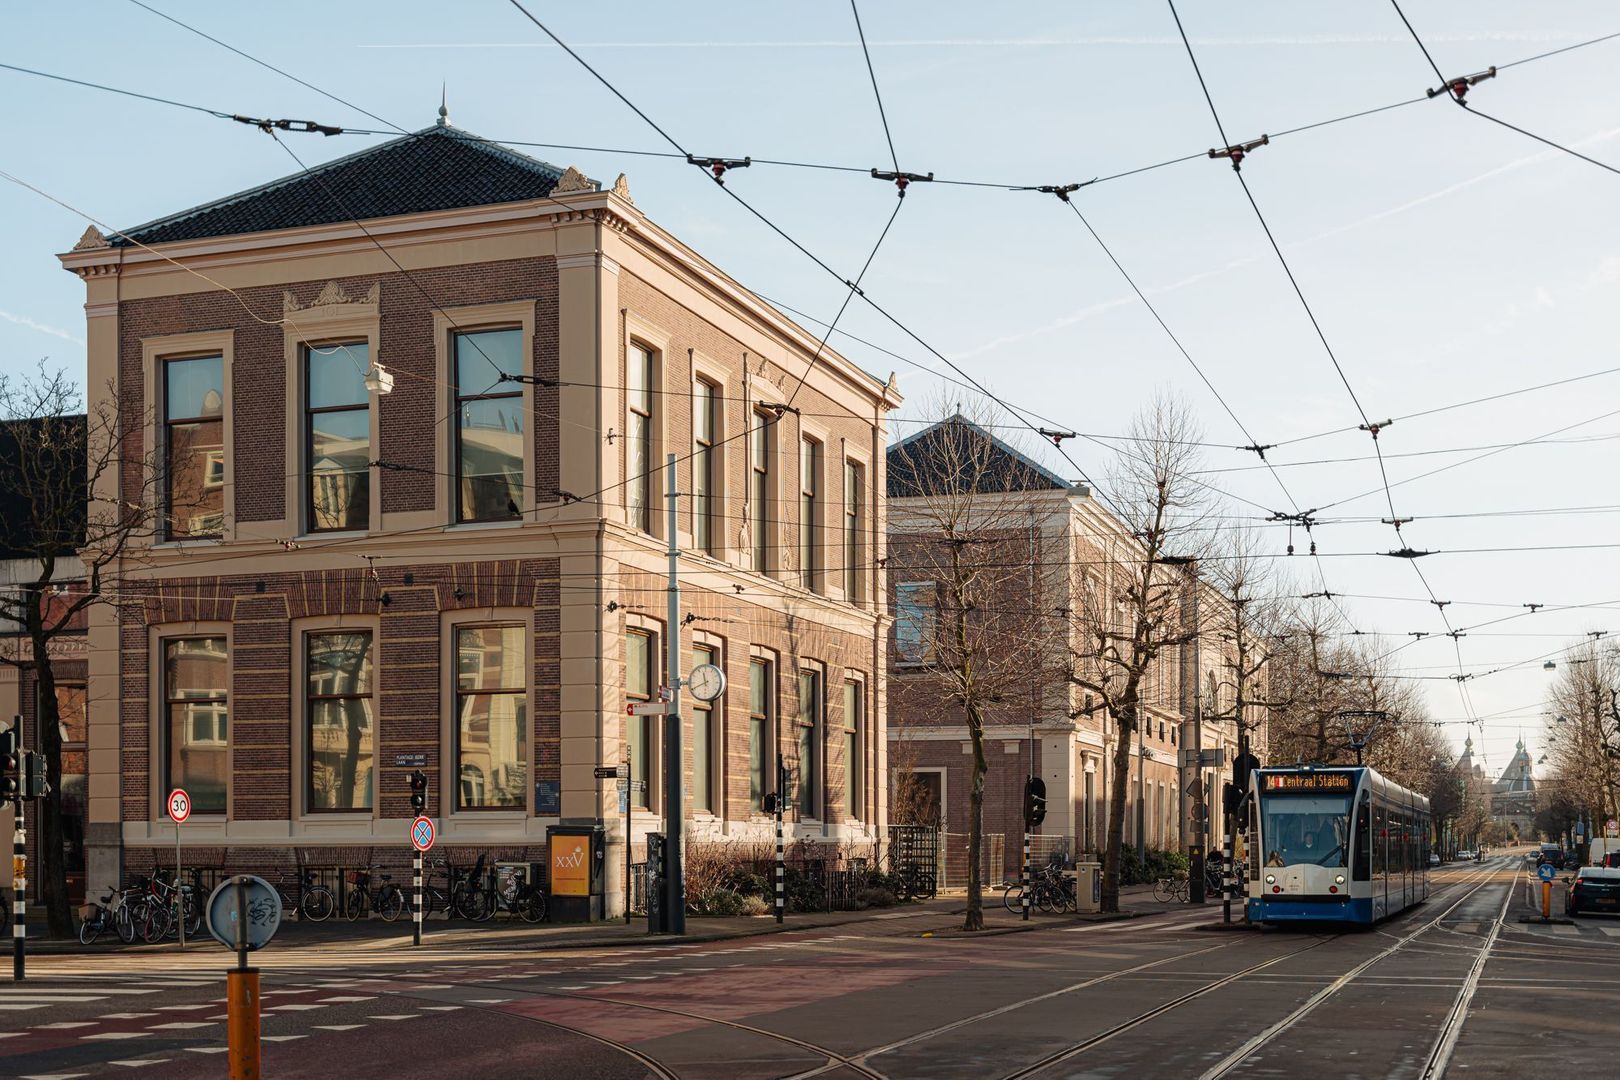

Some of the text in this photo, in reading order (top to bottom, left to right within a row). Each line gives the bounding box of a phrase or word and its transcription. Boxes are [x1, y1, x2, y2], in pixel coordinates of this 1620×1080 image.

[1283, 775, 1316, 787] Centraal
[1318, 774, 1349, 787] Station
[173, 800, 187, 812] 30
